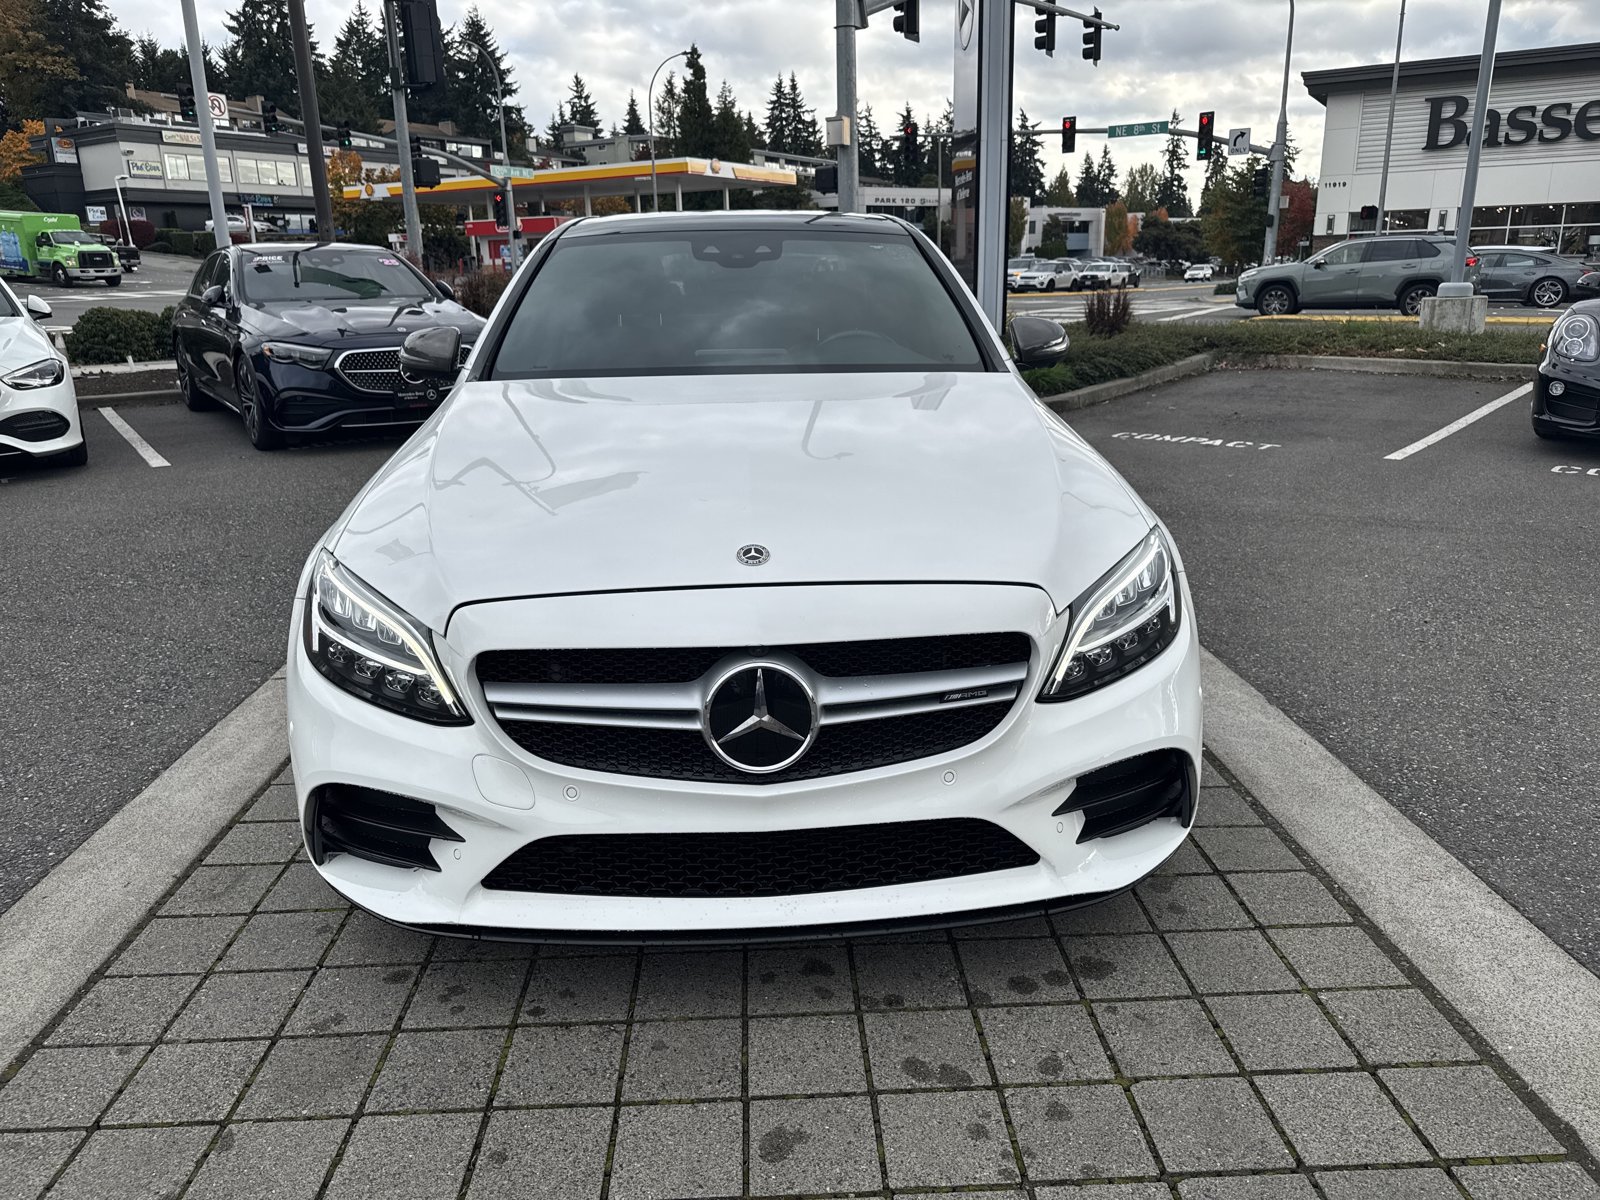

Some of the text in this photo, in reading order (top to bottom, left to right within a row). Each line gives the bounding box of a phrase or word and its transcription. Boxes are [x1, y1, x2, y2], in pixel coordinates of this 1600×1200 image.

[1115, 123, 1161, 137] NE 8th St
[1111, 431, 1282, 450] COMPACT
